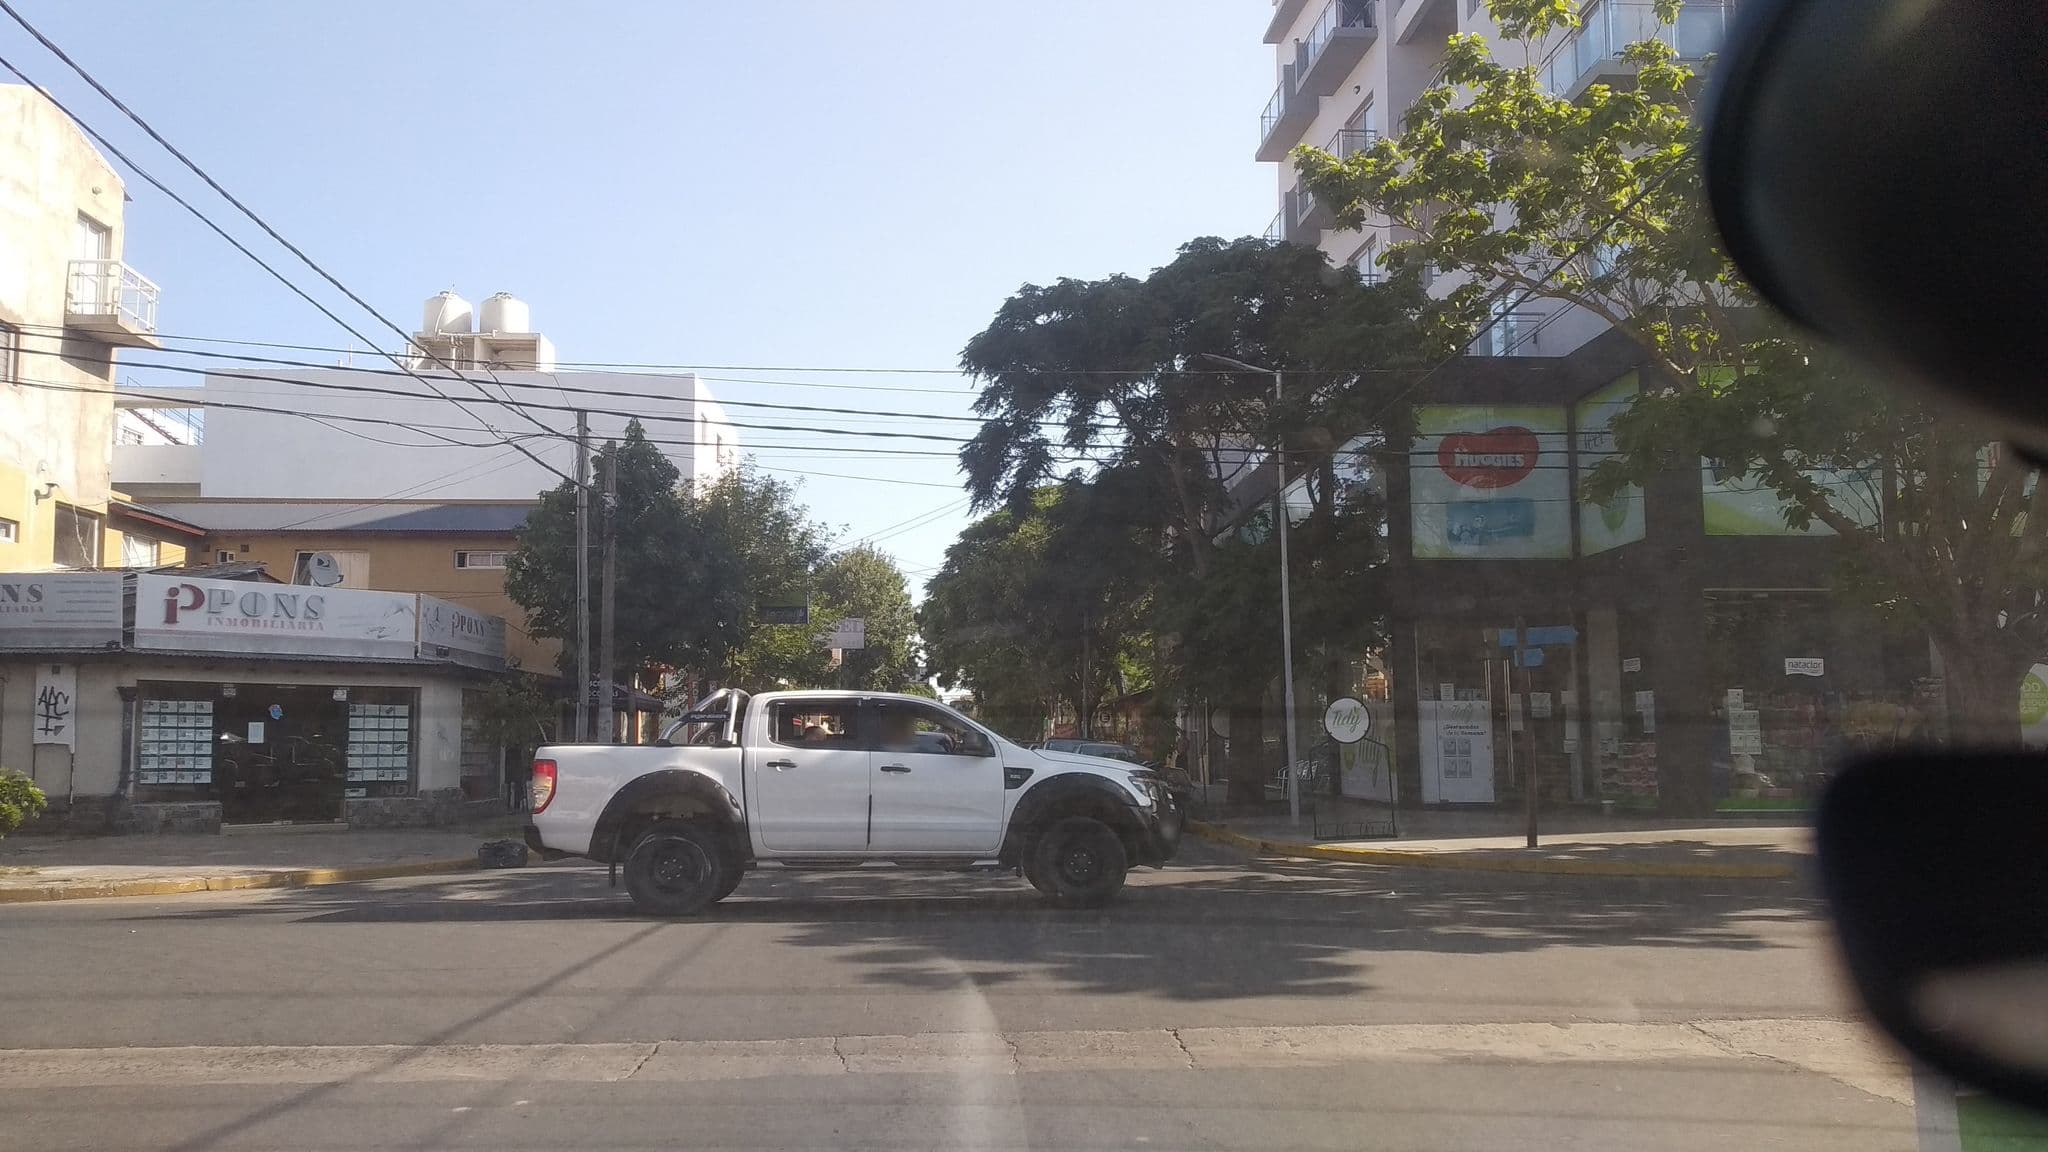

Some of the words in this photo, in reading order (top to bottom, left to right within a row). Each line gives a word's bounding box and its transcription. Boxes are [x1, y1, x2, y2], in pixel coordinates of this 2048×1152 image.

[207, 588, 325, 620] PONS
[207, 617, 325, 631] INMOBILIARIA
[1788, 660, 1822, 669] nataclor
[1332, 706, 1361, 733] Tidy
